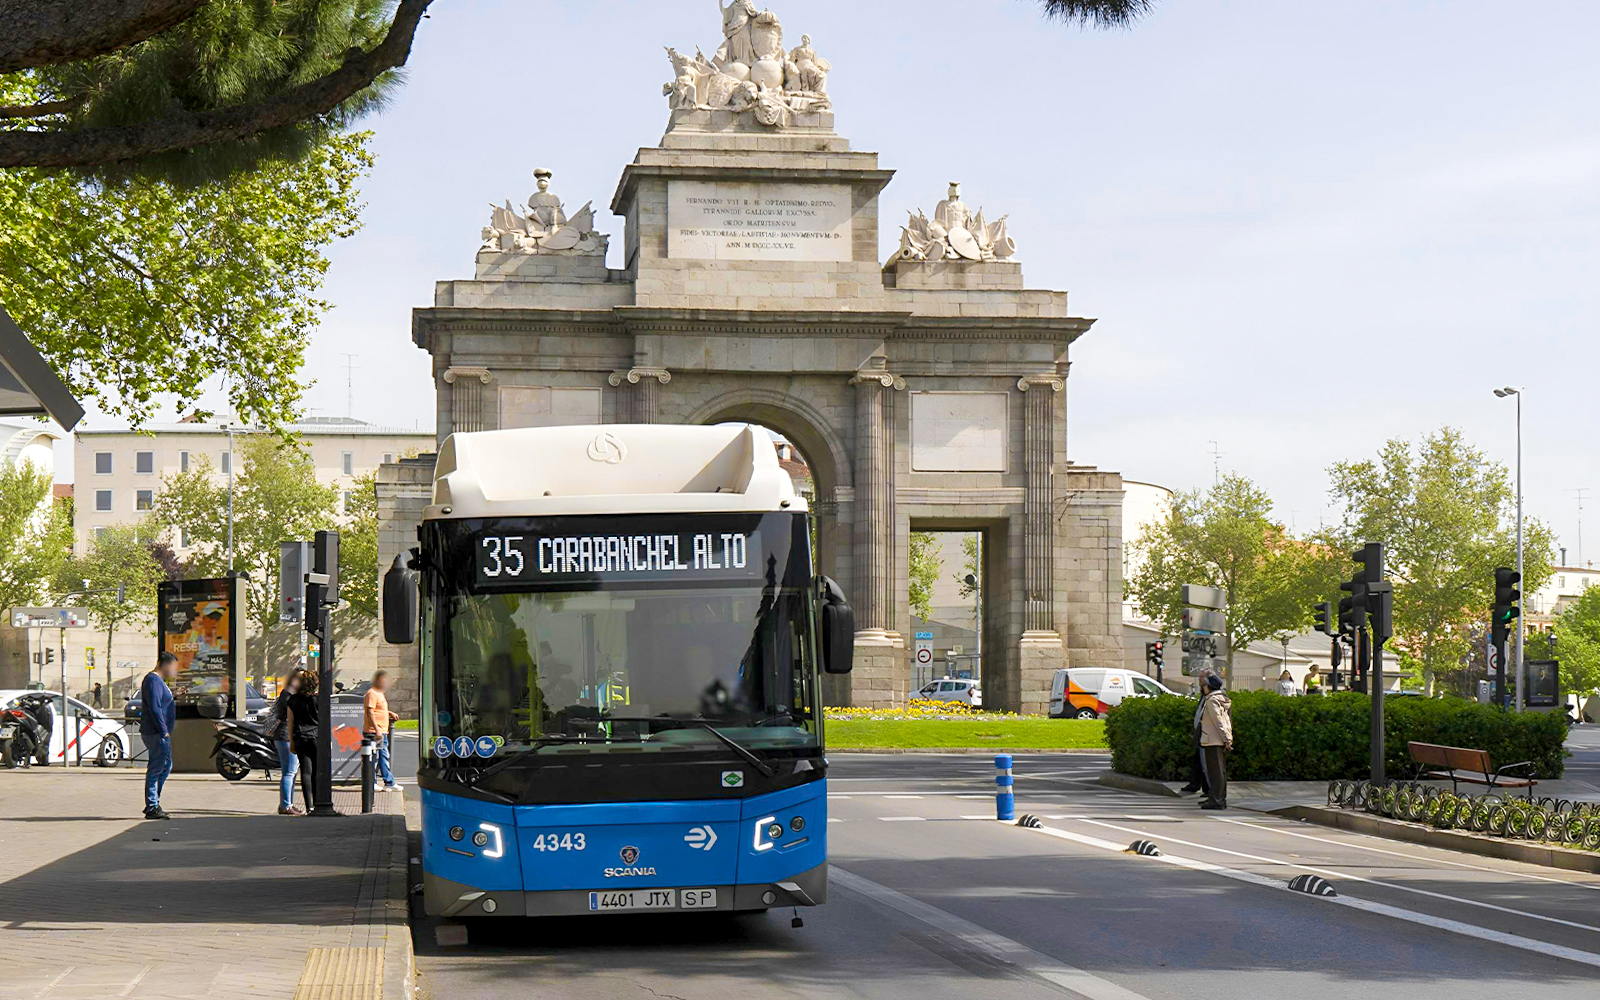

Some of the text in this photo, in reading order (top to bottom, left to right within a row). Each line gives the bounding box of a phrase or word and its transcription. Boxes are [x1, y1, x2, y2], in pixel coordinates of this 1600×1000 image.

[722, 219, 744, 227] ORDO
[482, 533, 746, 577] 35 CARABANCHEL ALTO
[173, 642, 204, 652] RESET
[532, 832, 586, 852] 4343
[604, 867, 657, 878] SCANIA
[601, 892, 671, 908] 4401 JTX
